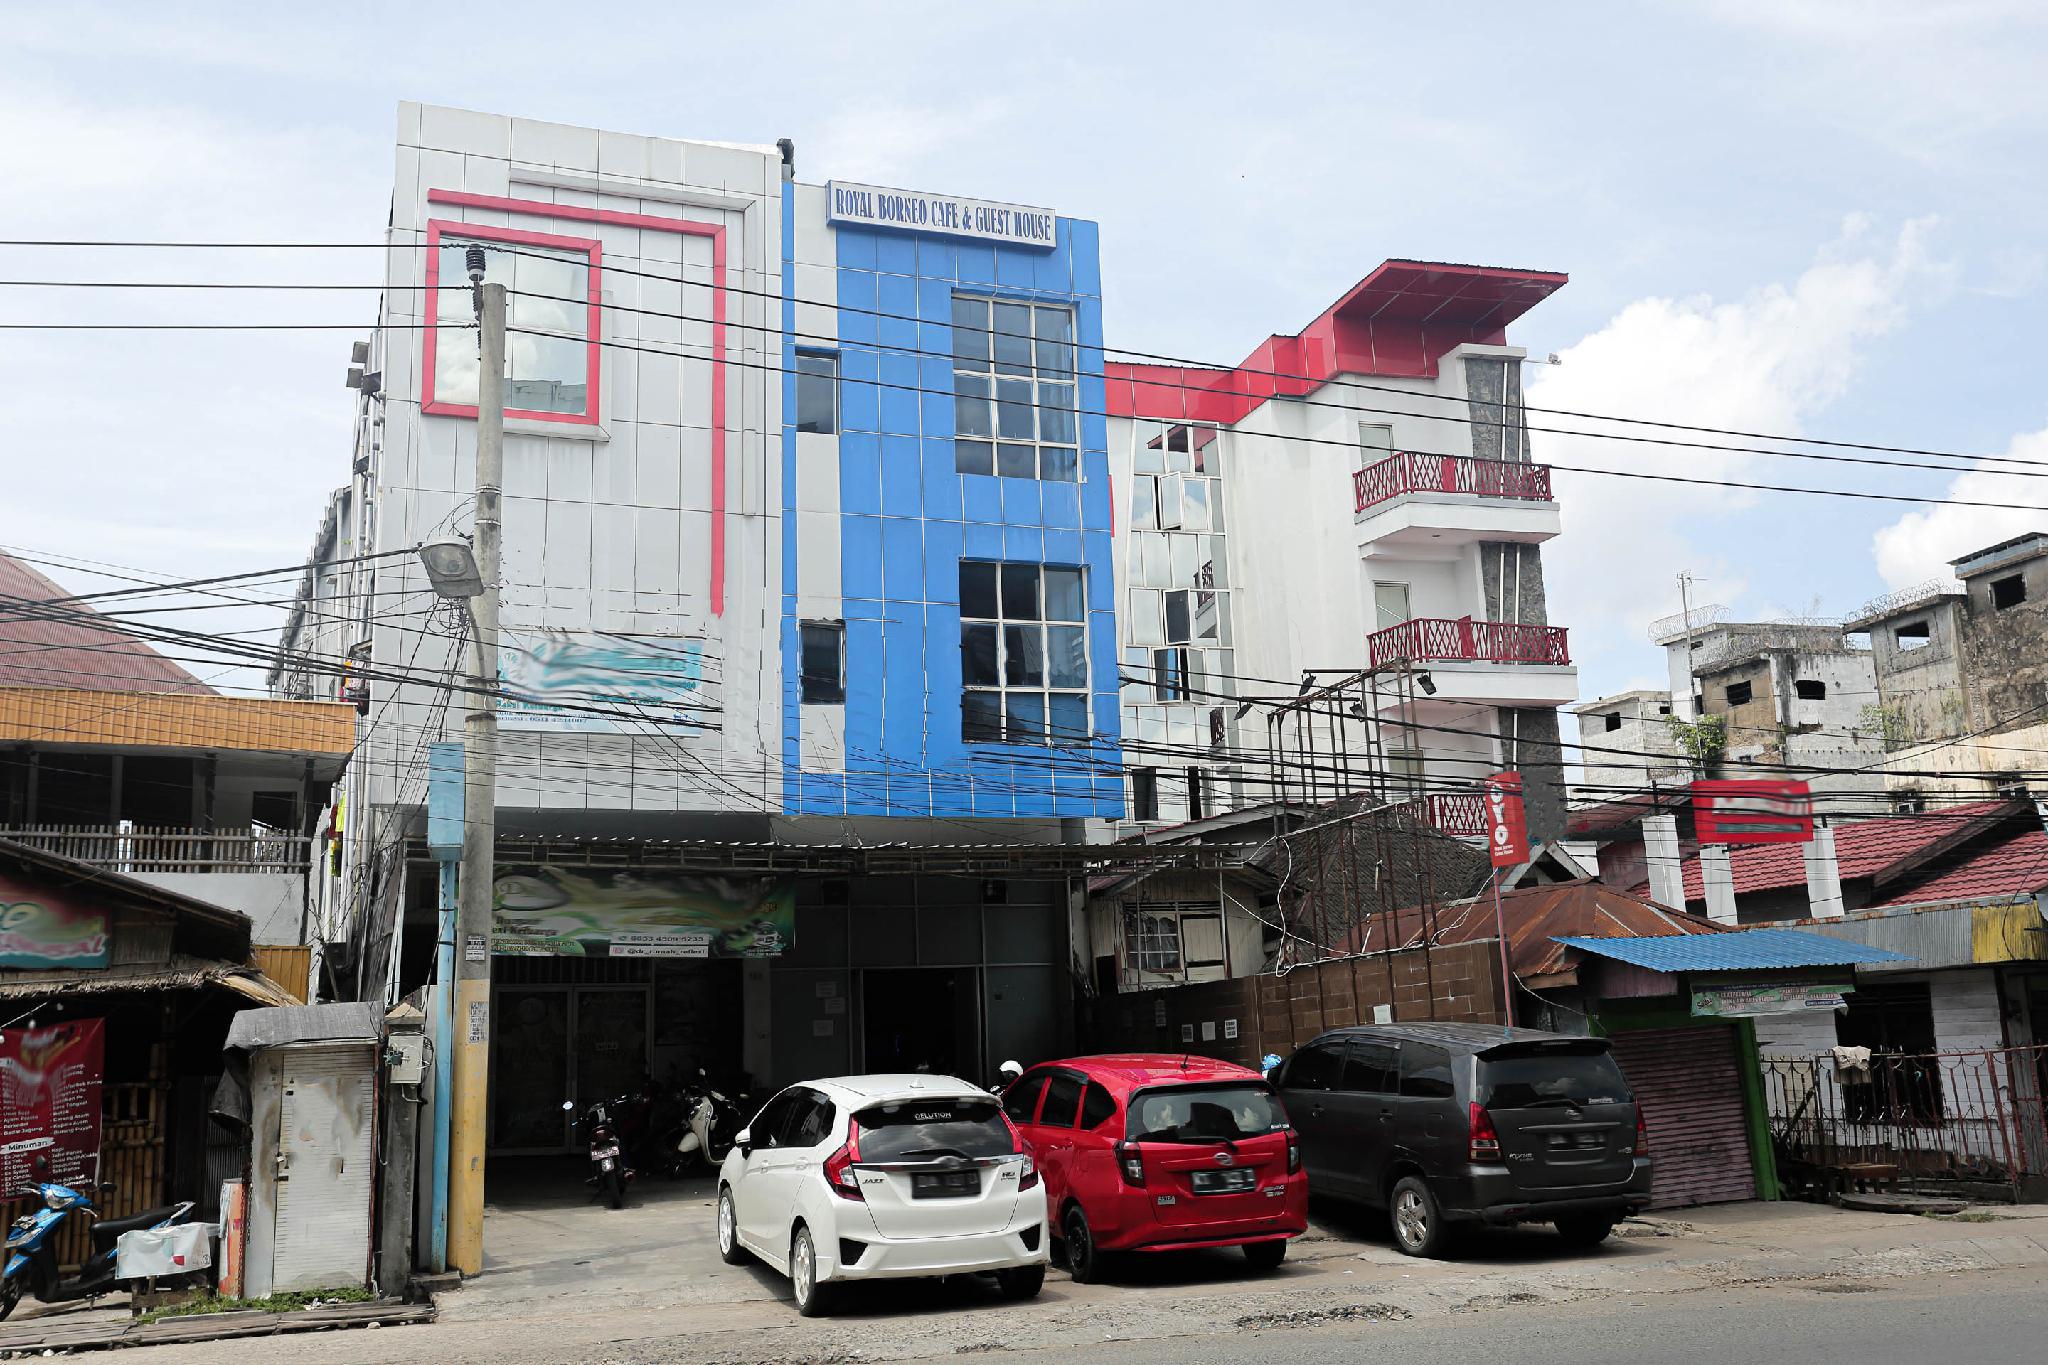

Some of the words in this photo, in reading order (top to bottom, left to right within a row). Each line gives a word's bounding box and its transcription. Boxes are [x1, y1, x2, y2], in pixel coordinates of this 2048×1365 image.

[836, 188, 875, 218] ROYAL
[878, 194, 927, 225] BORNEO
[931, 200, 959, 229] CAFE
[962, 206, 972, 231] &
[975, 206, 1010, 235] GUEST
[1014, 212, 1051, 241] HOUSE
[8, 1140, 48, 1151] Minuman
